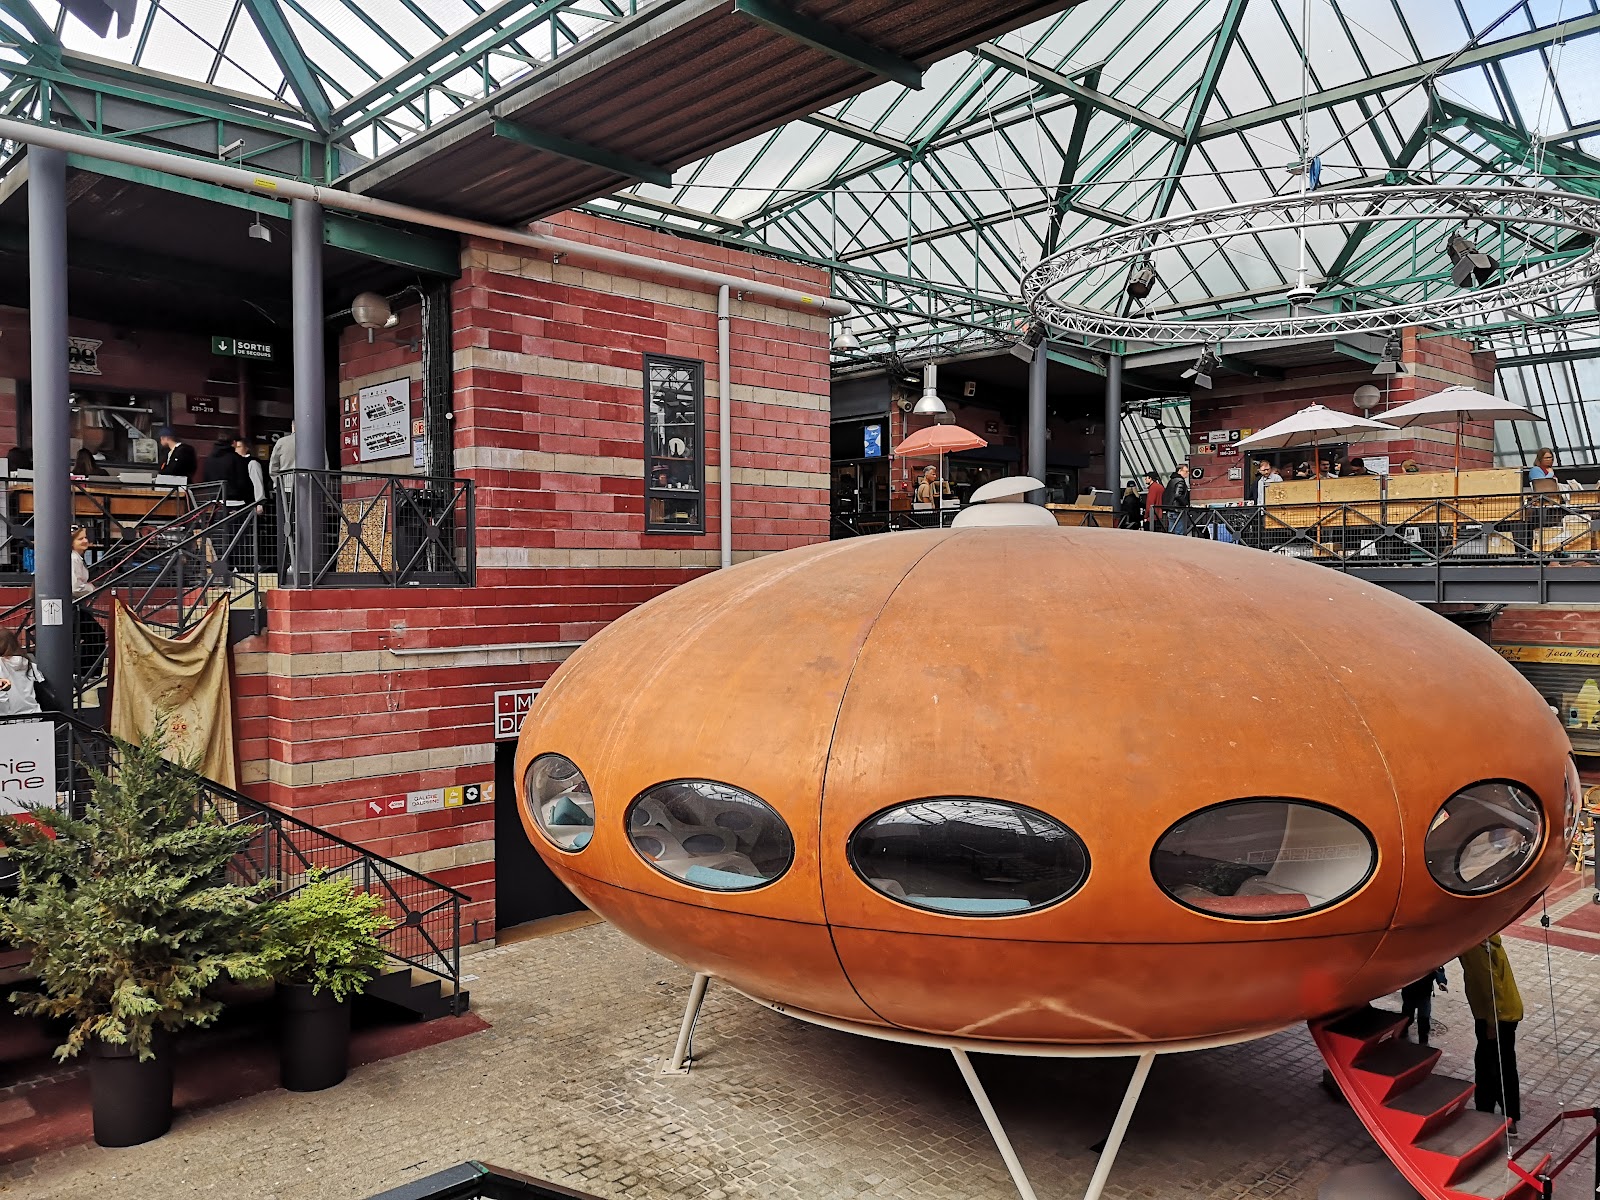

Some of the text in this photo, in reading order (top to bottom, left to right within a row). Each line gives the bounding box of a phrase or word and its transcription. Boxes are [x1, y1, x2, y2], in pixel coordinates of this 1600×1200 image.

[237, 341, 271, 352] SORTIE
[1545, 648, 1573, 658] Jean
[2, 776, 45, 792] ne
